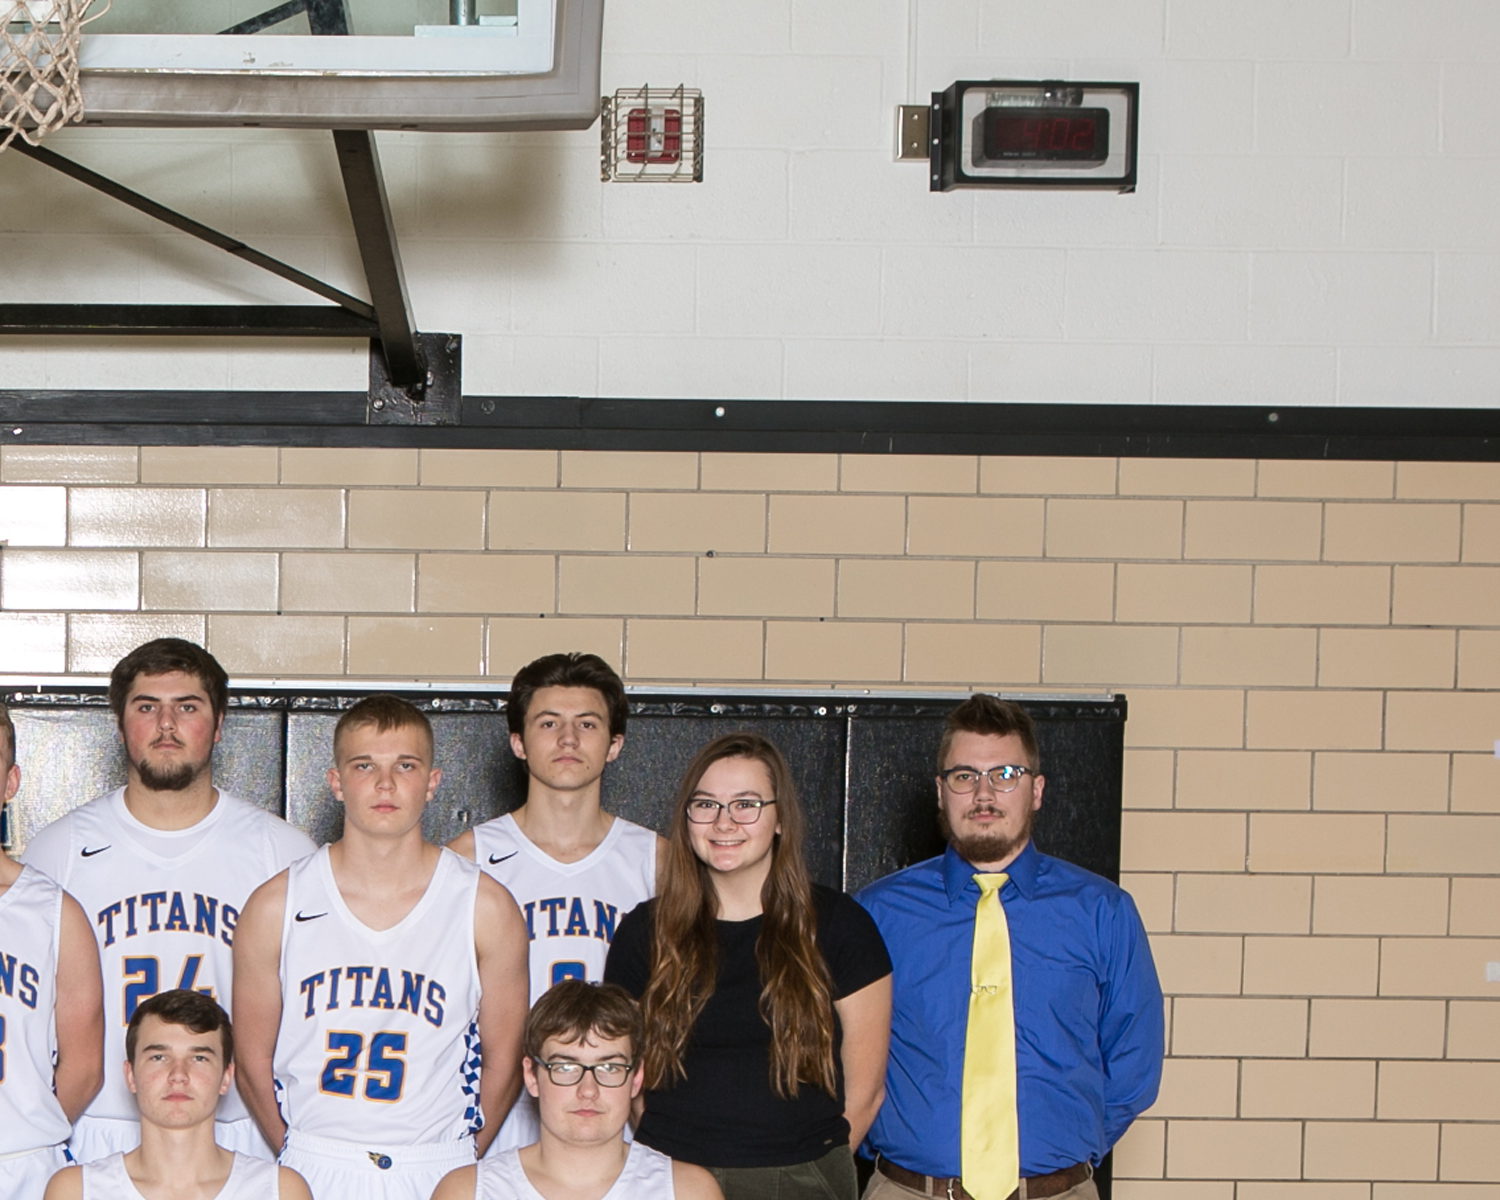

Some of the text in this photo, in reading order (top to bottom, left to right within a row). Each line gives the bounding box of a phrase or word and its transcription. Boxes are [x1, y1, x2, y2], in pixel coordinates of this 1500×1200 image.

[97, 890, 240, 949] TITANS
[300, 965, 447, 1029] TITANS
[317, 1028, 409, 1105] 25
